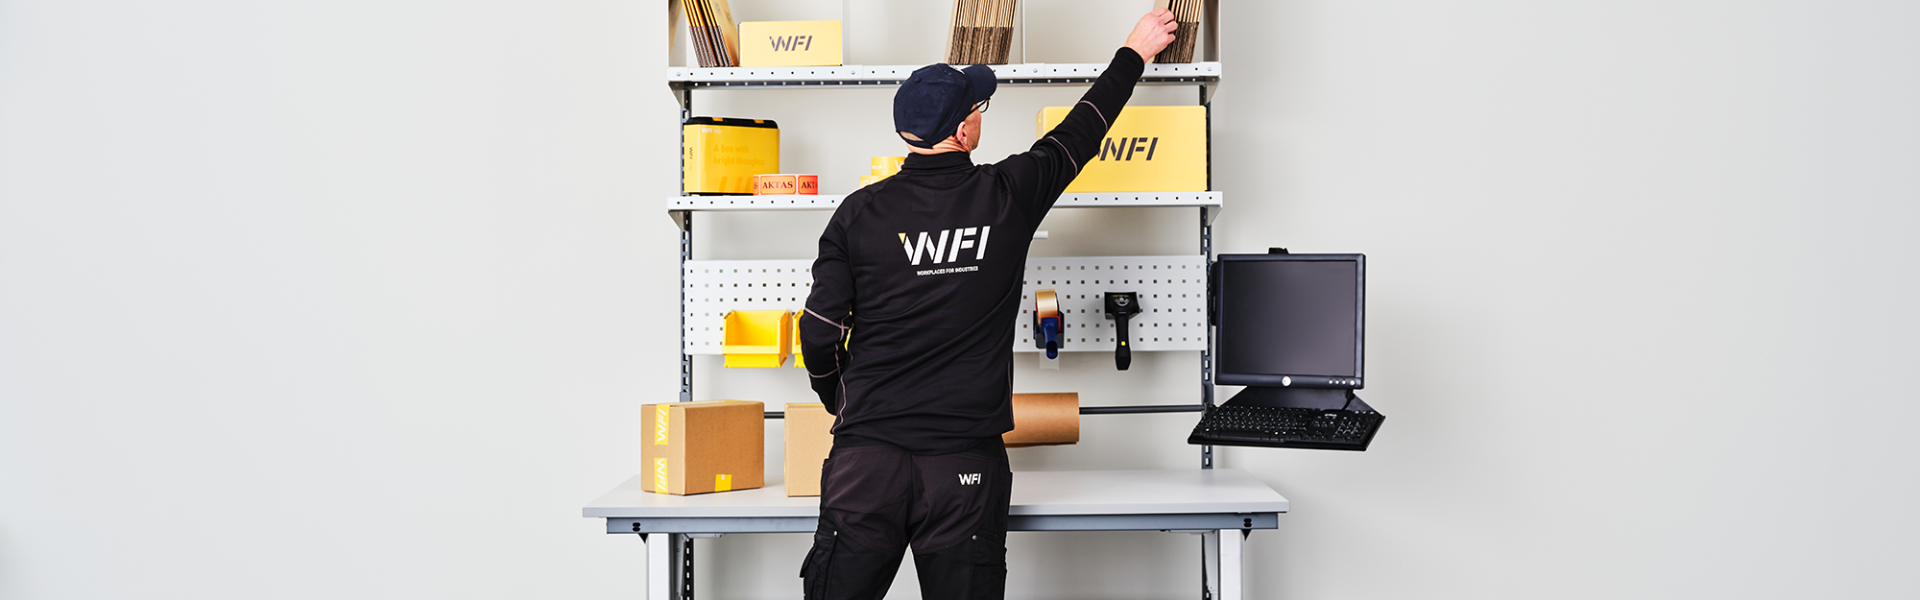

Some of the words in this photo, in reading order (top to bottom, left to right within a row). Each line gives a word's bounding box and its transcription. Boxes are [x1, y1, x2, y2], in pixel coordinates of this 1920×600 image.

[769, 35, 813, 52] WFI
[713, 144, 720, 152] A
[721, 144, 734, 153] box
[735, 144, 750, 154] with
[713, 155, 735, 167] bright
[736, 156, 766, 168] thoughts
[762, 181, 794, 189] AKTAS
[898, 225, 991, 266] WFI
[955, 265, 979, 273] INDUSTRIES
[656, 408, 668, 442] WFI
[656, 457, 667, 491] WFI
[958, 473, 982, 486] WFI
